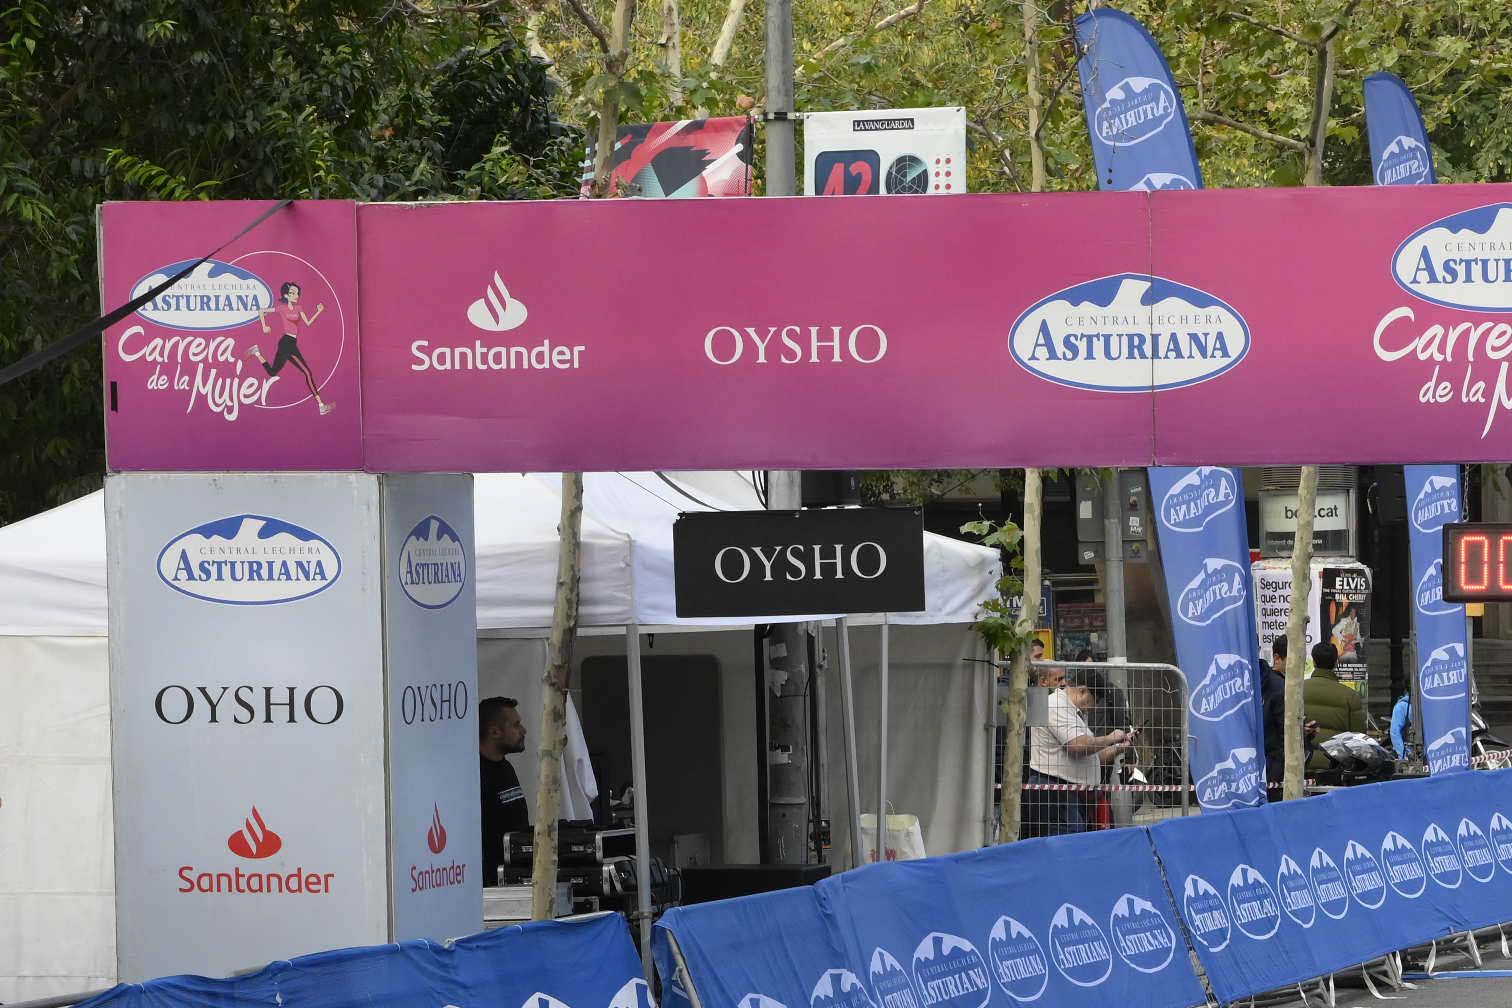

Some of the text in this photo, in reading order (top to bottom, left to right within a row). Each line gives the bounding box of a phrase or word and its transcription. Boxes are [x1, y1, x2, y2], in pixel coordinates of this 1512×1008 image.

[168, 282, 207, 292] ENTRAL
[1065, 313, 1222, 327] CENTRAL LECHERA
[118, 325, 236, 362] Carrera
[411, 339, 585, 371] Santander
[704, 324, 888, 365] OYSHO
[1028, 318, 1231, 361] ASTURIANA
[147, 361, 280, 421] de la Mujer
[1419, 364, 1453, 403] de
[1461, 363, 1486, 403] la
[172, 548, 328, 583] ASTURIANA
[199, 545, 321, 556] CENTRAL LECHERA
[405, 550, 462, 585] ASTURIANA
[714, 541, 887, 583] OYSHO
[1261, 595, 1276, 604] que
[1336, 577, 1366, 590] ELVIS
[1261, 606, 1293, 617] quiere
[155, 685, 343, 725] OYSHO
[402, 680, 467, 725] OYSHO
[178, 867, 334, 894] Santander
[411, 861, 466, 893] Santander
[1054, 936, 1109, 969] ASTURIANA
[919, 966, 988, 1006] ASTURIANA
